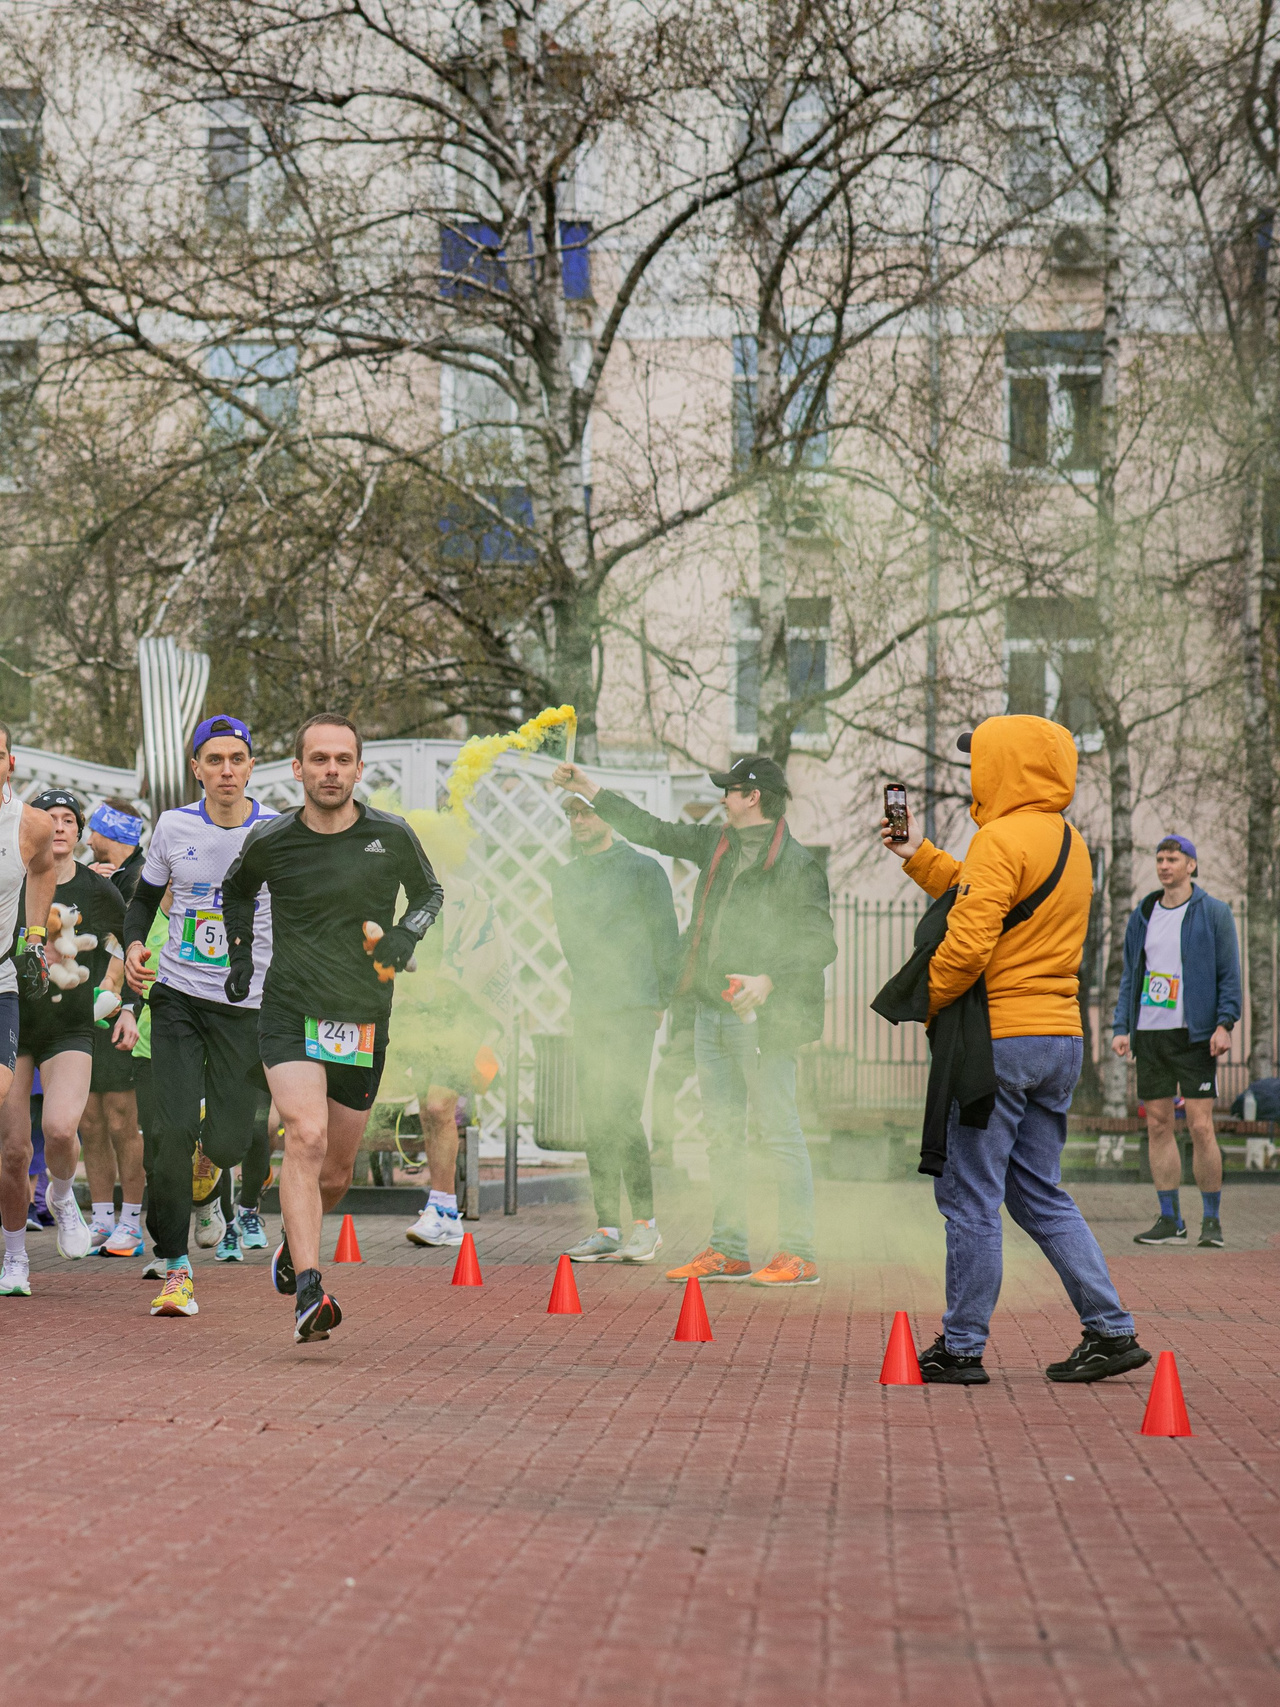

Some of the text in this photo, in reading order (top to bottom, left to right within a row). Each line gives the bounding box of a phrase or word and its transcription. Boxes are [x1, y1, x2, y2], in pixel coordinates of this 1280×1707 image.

[205, 926, 216, 944] 5
[1151, 981, 1163, 993] 22
[324, 1020, 346, 1041] 24
